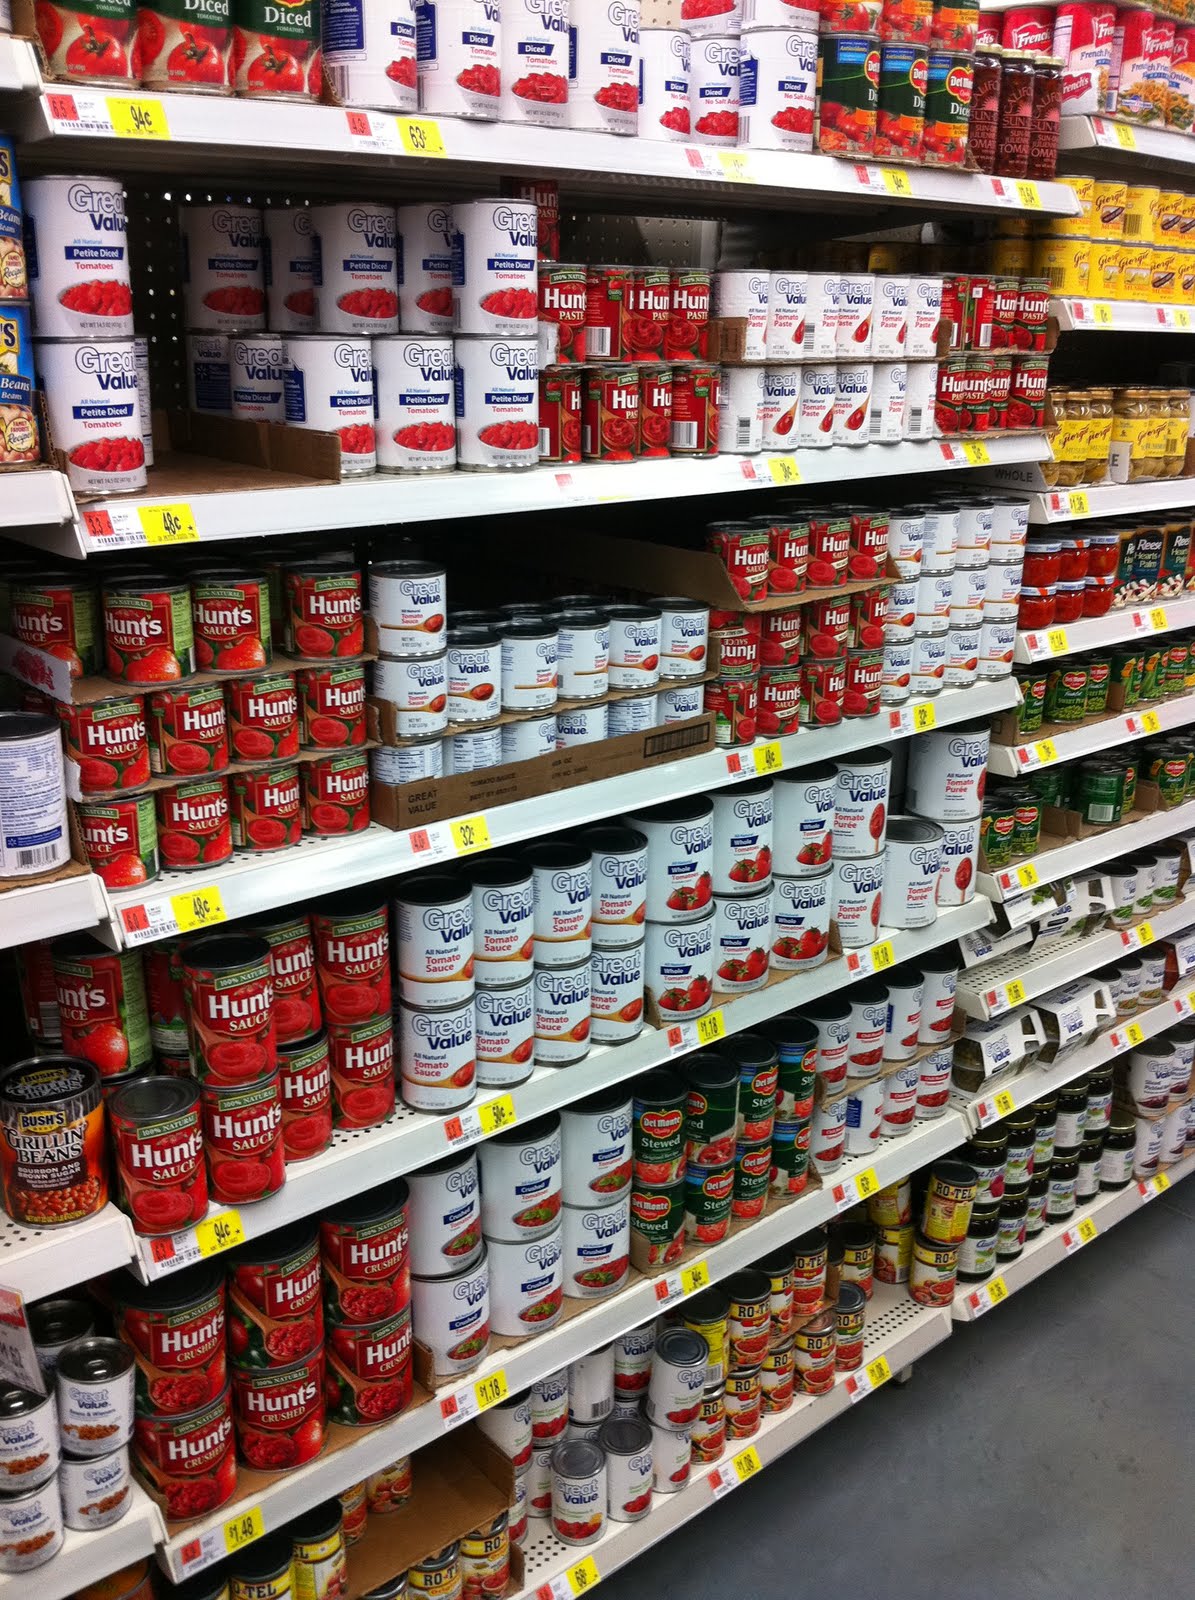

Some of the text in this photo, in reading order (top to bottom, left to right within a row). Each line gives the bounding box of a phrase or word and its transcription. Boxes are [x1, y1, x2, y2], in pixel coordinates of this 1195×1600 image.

[264, 7, 311, 28] Diced
[470, 34, 488, 44] Diced
[525, 44, 545, 54] Diced
[526, 56, 557, 65] Tomatoes
[607, 54, 625, 64] Diced
[705, 89, 722, 97] Diced
[785, 83, 800, 91] Diced
[74, 249, 119, 258] Petite Diced
[75, 262, 114, 270] Tomatoes
[350, 262, 371, 270] Petite
[495, 261, 513, 270] Petite
[351, 272, 383, 281] Tomatoes
[495, 272, 526, 281] Tomatoes
[560, 310, 585, 321] PASTE
[1, 379, 31, 392] Beans
[767, 386, 796, 397] Value
[406, 395, 445, 406] Petite Diced
[492, 394, 530, 404] Petite Diced
[81, 406, 129, 418] Petite Diced
[338, 409, 367, 417] Tomatoes
[406, 406, 440, 416] Tomatoes
[492, 405, 524, 414] Tomatoes
[802, 410, 820, 418] Paste
[82, 420, 122, 429] Tomatoes
[995, 467, 1034, 482] WHOLE
[209, 590, 243, 600] NATURAL
[400, 580, 440, 597] Great
[309, 595, 361, 615] Hunt's
[412, 593, 442, 607] Value
[324, 614, 355, 625] SAUCE
[204, 625, 238, 636] SAUCE
[114, 634, 146, 647] SAUCE
[448, 651, 490, 666] Great
[459, 663, 491, 674] Value
[248, 697, 298, 719] Hunt's
[340, 703, 363, 715] SAUCE
[674, 701, 699, 713] Value
[264, 715, 293, 727] SAUCE
[87, 719, 146, 746] Hunt's
[200, 725, 225, 740] SAUCE
[105, 742, 139, 756] SAUCE
[839, 767, 888, 790] Great
[946, 778, 974, 786] Tomato
[341, 789, 366, 802] SAUCE
[408, 789, 438, 803] GREAT
[849, 786, 886, 803] Value
[173, 797, 229, 821] Hunt's
[408, 801, 438, 816] VALUE
[834, 813, 865, 822] Tomato
[188, 818, 221, 831] SAUCE
[734, 838, 753, 847] Whole
[672, 865, 691, 874] Whole
[780, 880, 827, 900] Great
[908, 886, 934, 896] Tomato
[601, 898, 634, 909] Tomato
[792, 893, 827, 910] Value
[600, 907, 627, 916] Sauce
[838, 905, 868, 914] Tomato
[778, 917, 796, 925] Whole
[485, 933, 520, 945] Tomato
[664, 923, 713, 948] Great
[328, 930, 390, 965] Hunt's
[485, 943, 512, 953] Sauce
[678, 939, 712, 959] Value
[426, 952, 462, 965] Tomato
[345, 957, 383, 977] SAUCE
[426, 963, 455, 974] Sauce
[664, 967, 684, 976] Whole
[275, 969, 312, 989] SAUCE
[535, 965, 591, 994] Great
[600, 968, 641, 987] Value
[664, 973, 693, 982] Tomatoes
[208, 981, 274, 1020] Hunt's
[550, 984, 591, 1007] Value
[229, 1011, 269, 1033] SAUCE
[412, 1007, 473, 1038] Great
[427, 1029, 473, 1051] Value
[424, 1052, 447, 1061] Natural
[414, 1060, 450, 1070] Tomato
[414, 1068, 441, 1079] Sauce
[223, 1088, 277, 1109] 100% NATURAL
[21, 1112, 66, 1129] BUSH'S
[142, 1115, 197, 1138] 100% NATURAL
[213, 1101, 282, 1140] Hunt's
[643, 1116, 681, 1128] Del Monte
[232, 1131, 275, 1152] SAUCE
[641, 1137, 681, 1149] Stewed
[17, 1144, 83, 1165] BEANS
[131, 1129, 203, 1170] Hunt's
[598, 1150, 621, 1162] Crushed
[18, 1162, 81, 1175] BOURBON AND
[19, 1167, 81, 1180] BROWN SUGAR
[153, 1159, 196, 1182] SAUCE
[521, 1182, 545, 1197] Crushed
[642, 1200, 668, 1211] Monte
[596, 1219, 627, 1240] Value
[350, 1226, 408, 1265] Hunt's
[583, 1246, 606, 1256] Crushed
[526, 1277, 549, 1291] Crushed
[456, 1313, 478, 1329] Crushed
[161, 1309, 224, 1354] Hunt's
[177, 1336, 218, 1364] CRUSHED
[247, 1380, 317, 1413] Hunt's
[78, 1400, 109, 1410] Value
[261, 1405, 306, 1424] CRUSHED
[168, 1415, 232, 1461] Hunt's
[563, 1492, 599, 1506] Value
